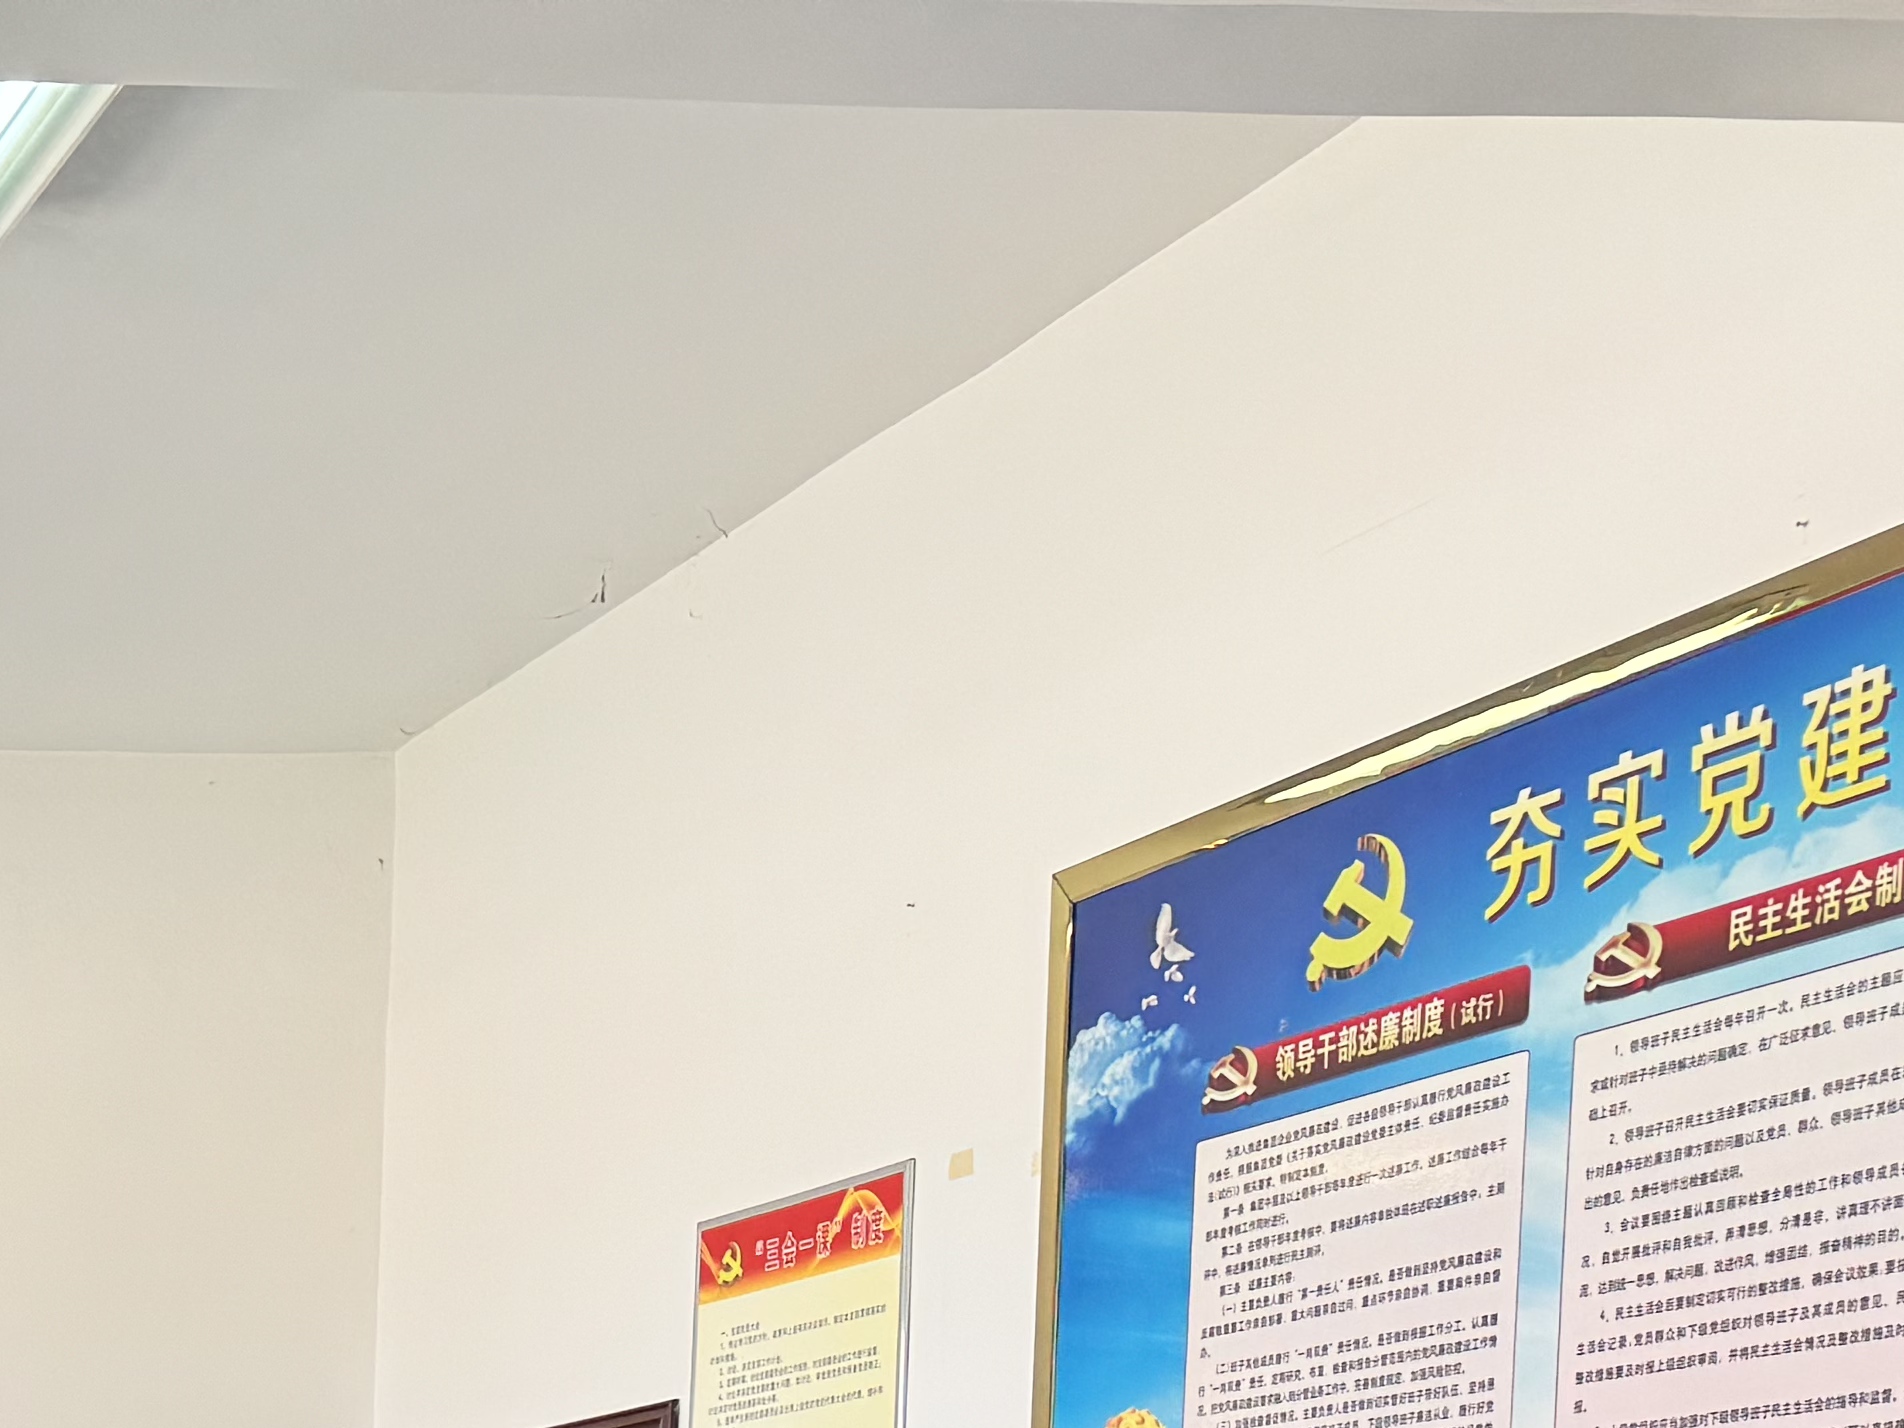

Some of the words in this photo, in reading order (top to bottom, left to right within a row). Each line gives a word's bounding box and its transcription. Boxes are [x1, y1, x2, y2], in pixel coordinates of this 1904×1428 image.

[1484, 663, 1896, 922] 夯实党建
[1728, 858, 1904, 951] 民主生活会制
